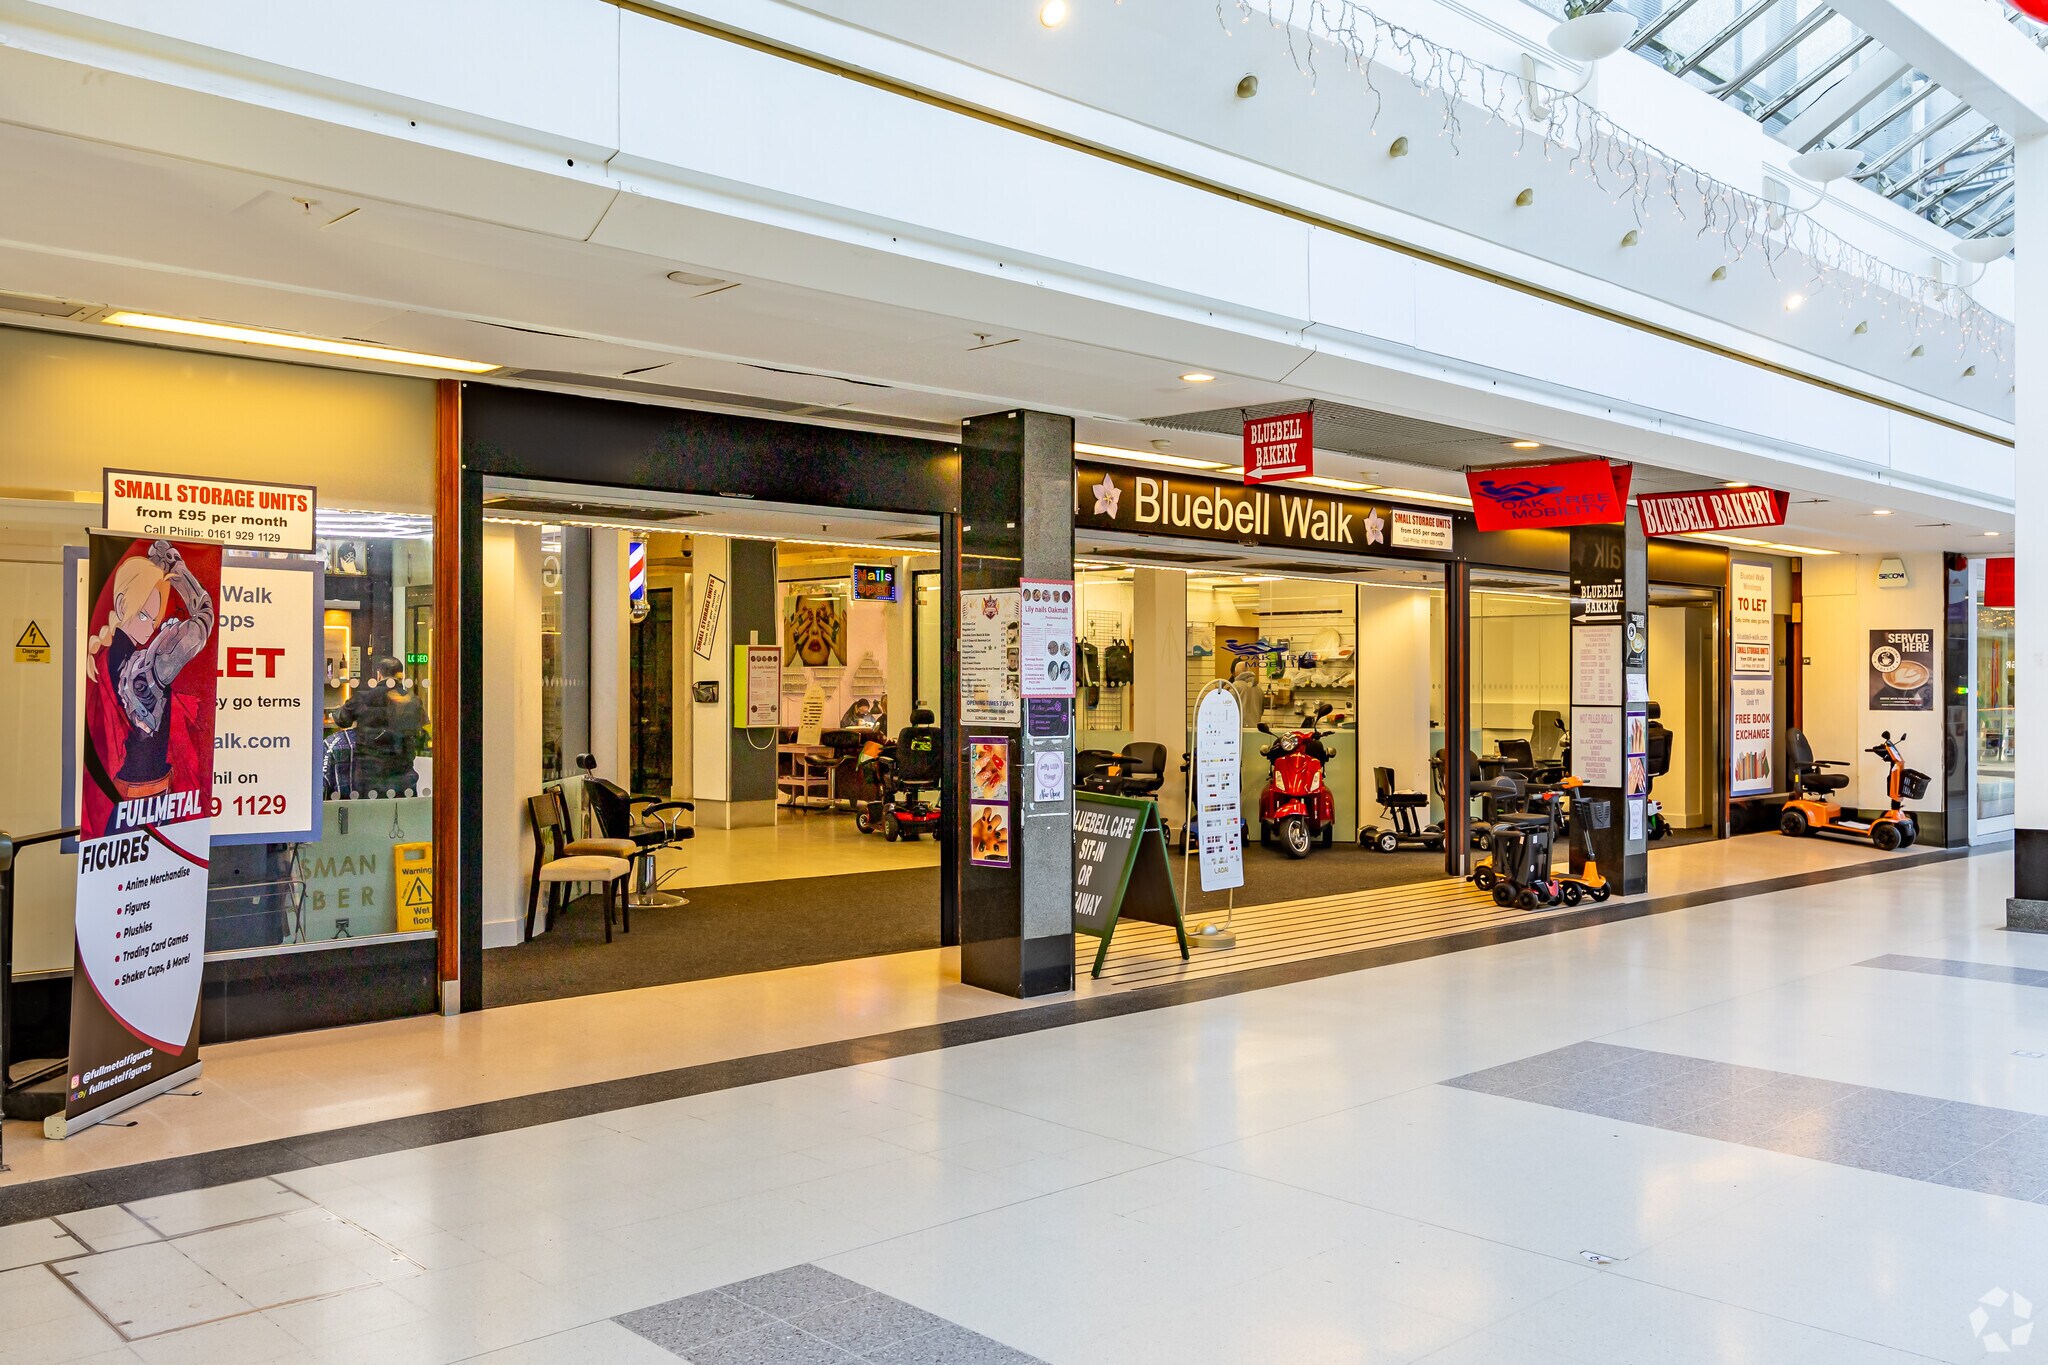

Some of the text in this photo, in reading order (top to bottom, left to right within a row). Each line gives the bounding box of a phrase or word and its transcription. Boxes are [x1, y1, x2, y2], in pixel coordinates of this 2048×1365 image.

[1250, 418, 1303, 445] BLUEBELL
[1255, 443, 1298, 467] BAKERY
[114, 479, 308, 512] SMALL STORAGE UNITS
[1501, 492, 1611, 511] OAK TREE
[136, 506, 288, 527] from £95 per month
[1135, 476, 1354, 544] Bluebell Walk
[1511, 503, 1607, 519] MOBILITY
[1642, 490, 1776, 534] BLUEBELL BAKERY
[1394, 513, 1451, 529] SMALL STORAGE UNITS
[144, 525, 281, 543] Call Philip: 0161 929 1129
[858, 569, 892, 582] Nails
[222, 585, 272, 603] Walk
[857, 584, 890, 596] open
[1580, 585, 1623, 598] BLUEBELL
[1585, 600, 1619, 613] BAKERY
[1738, 597, 1766, 611] TO LET
[1888, 633, 1929, 643] SERVED
[1902, 643, 1929, 652] HERE
[233, 698, 252, 710] go
[257, 696, 301, 708] terms
[1735, 713, 1770, 724] FREE BOOK
[1735, 729, 1770, 740] EXCHANGE
[238, 774, 258, 784] on
[115, 790, 202, 829] FULLMETAL
[233, 795, 287, 816] 1129
[1073, 810, 1135, 839] LUEBELL CAFE
[81, 835, 149, 874] FIGURES
[1079, 838, 1107, 863] SIT-IN
[125, 866, 190, 891] Anime Merchandise
[402, 867, 432, 875] Warning
[1077, 864, 1092, 887] OR
[124, 900, 150, 916] Figures
[414, 907, 430, 915] Wet
[1075, 891, 1103, 916] AWAY
[124, 921, 152, 938] Plushies
[123, 932, 189, 962] Trading Card Games
[121, 953, 190, 986] Shaker Cups, & More!
[82, 1047, 153, 1084] @fullmetalfigures
[89, 1062, 152, 1096] fullmetalfigures
